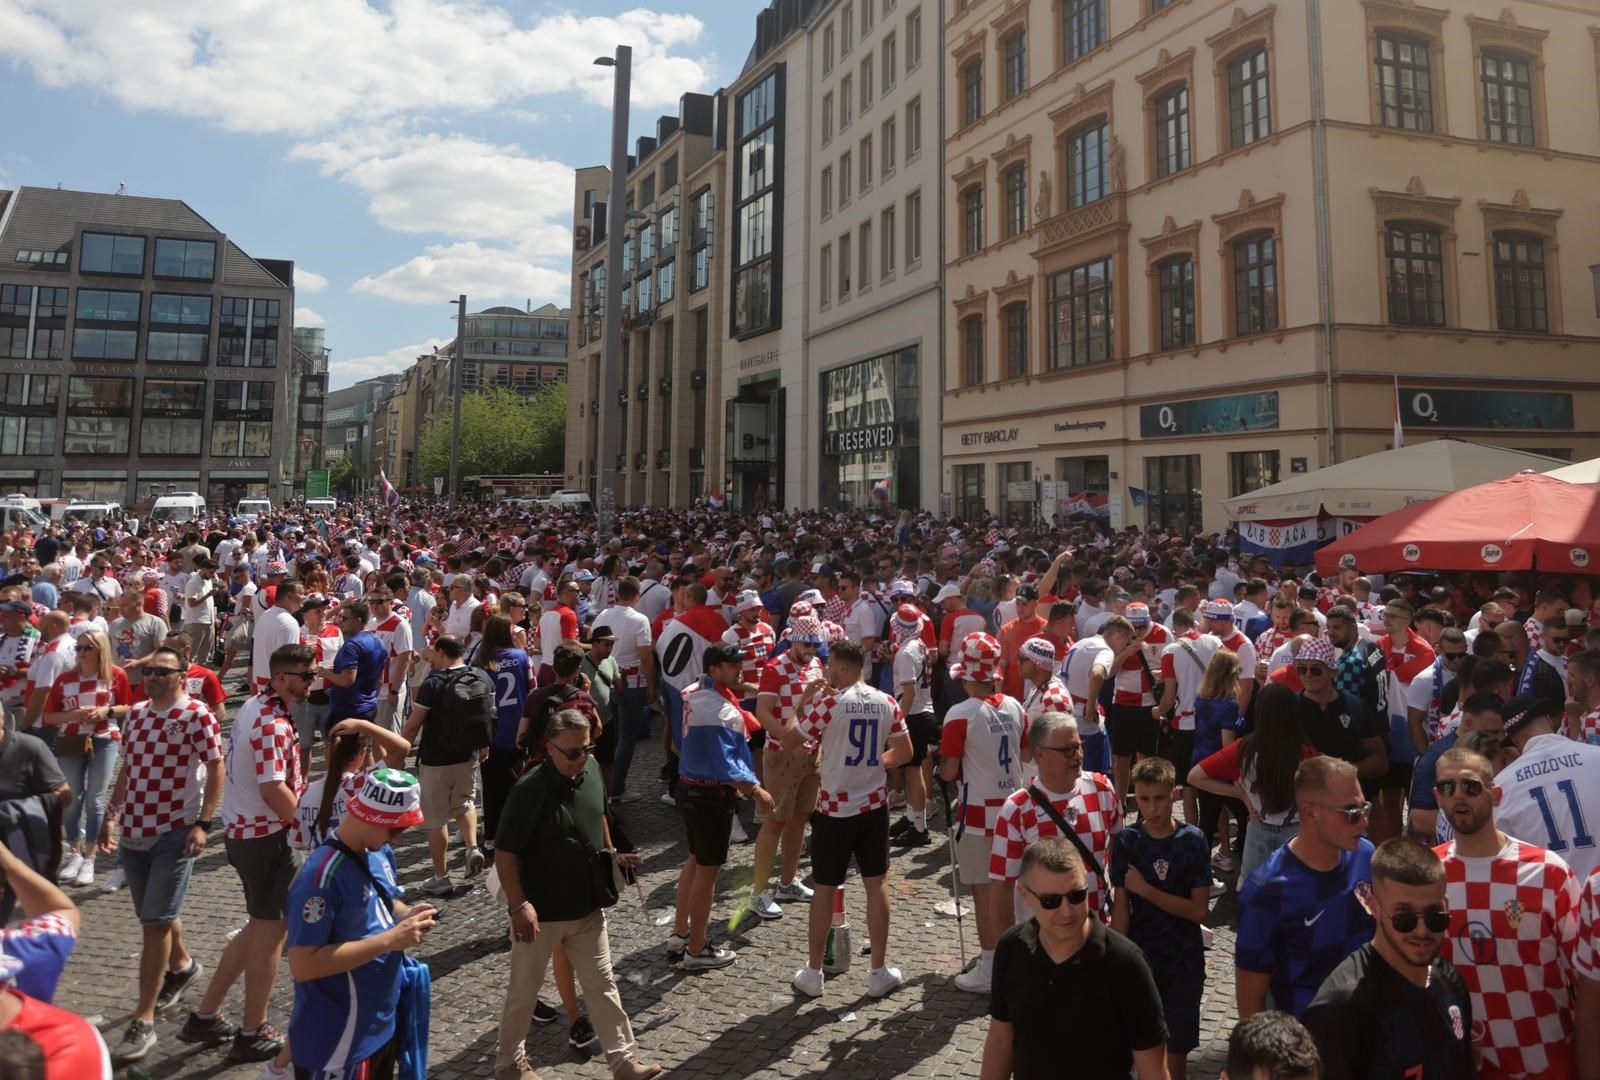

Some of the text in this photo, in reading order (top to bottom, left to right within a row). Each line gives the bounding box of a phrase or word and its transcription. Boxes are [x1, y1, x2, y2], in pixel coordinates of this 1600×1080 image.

[14, 362, 134, 373] MESSEHAUS
[157, 367, 178, 376] AM
[839, 425, 894, 451] RESERVED
[961, 428, 1018, 446] BETTY BARCLAY
[498, 671, 518, 707] 2
[845, 718, 879, 767] 91
[998, 735, 1012, 775] 4
[1515, 752, 1583, 782] BROZOVIĆ
[360, 780, 405, 807] ITALIA
[1529, 779, 1597, 853] 11
